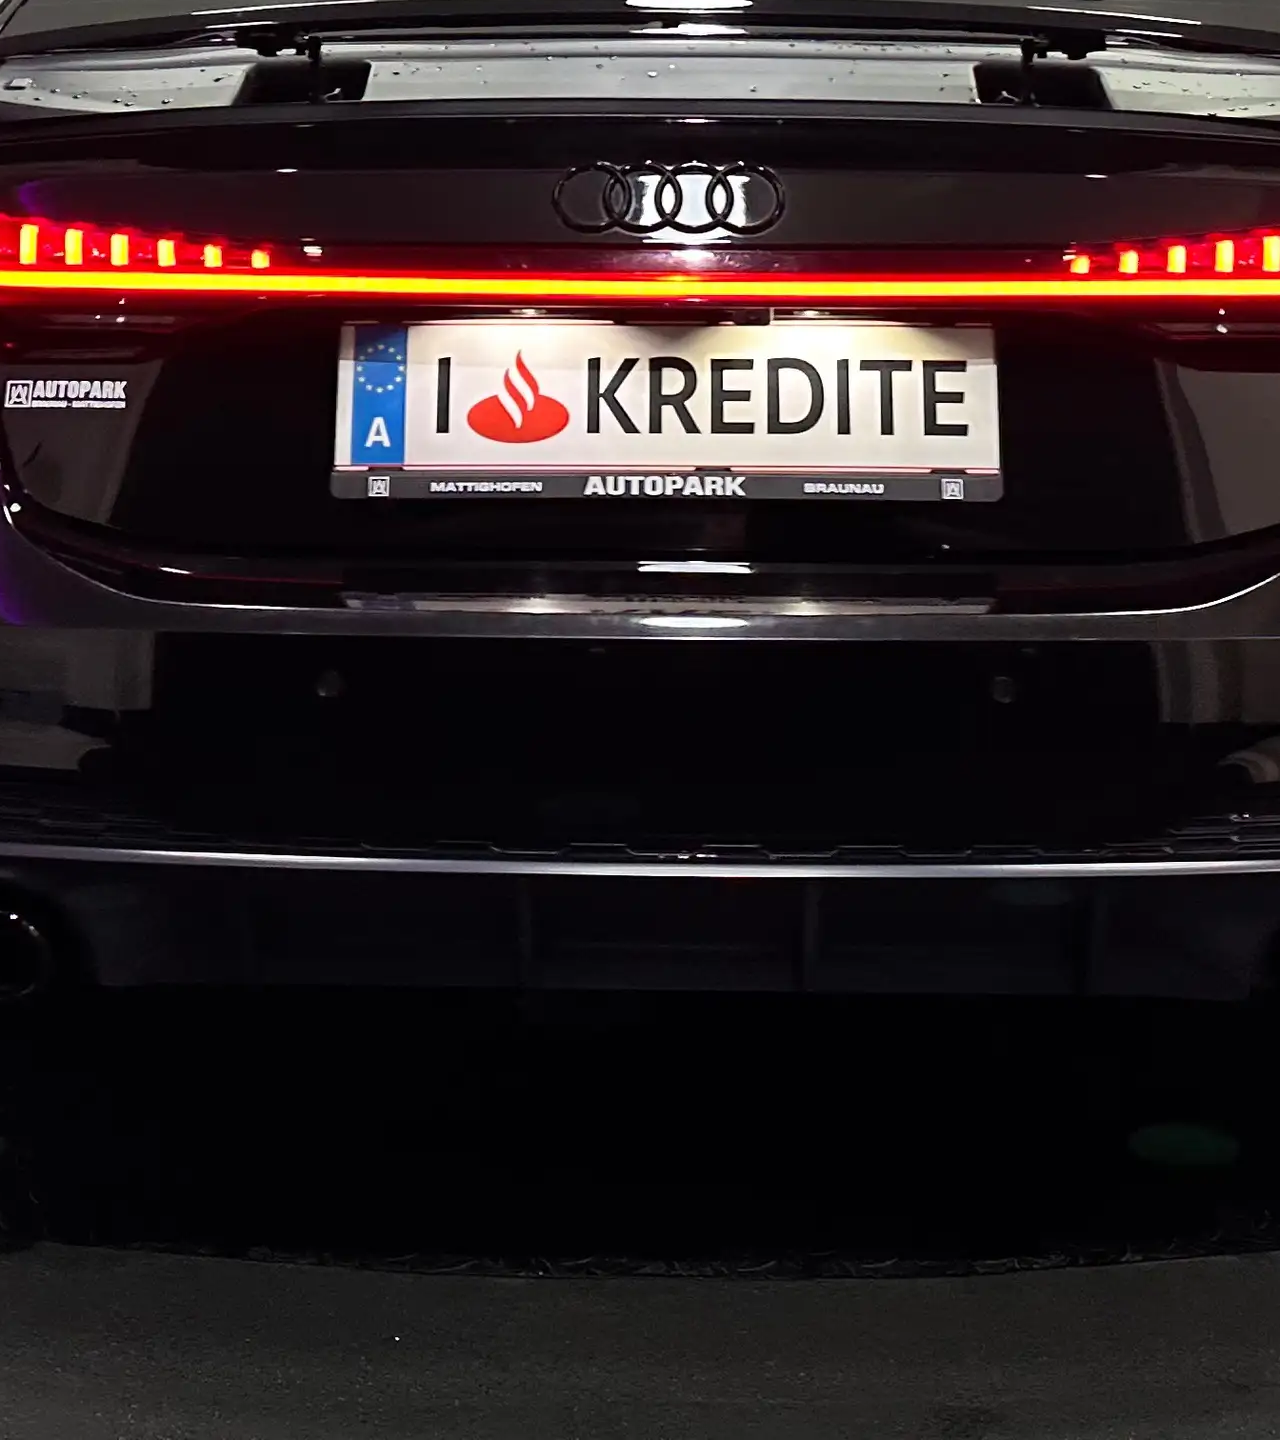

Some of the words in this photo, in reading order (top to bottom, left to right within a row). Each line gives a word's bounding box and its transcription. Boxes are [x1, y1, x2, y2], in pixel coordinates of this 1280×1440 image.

[33, 380, 127, 399] AUTOPARK
[435, 356, 450, 433] I
[588, 357, 968, 437] KREDITE
[365, 417, 390, 447] A
[430, 481, 543, 493] MATTIGHOFEN
[583, 476, 746, 496] AUTOPARK
[803, 482, 885, 494] BRAUNAU
